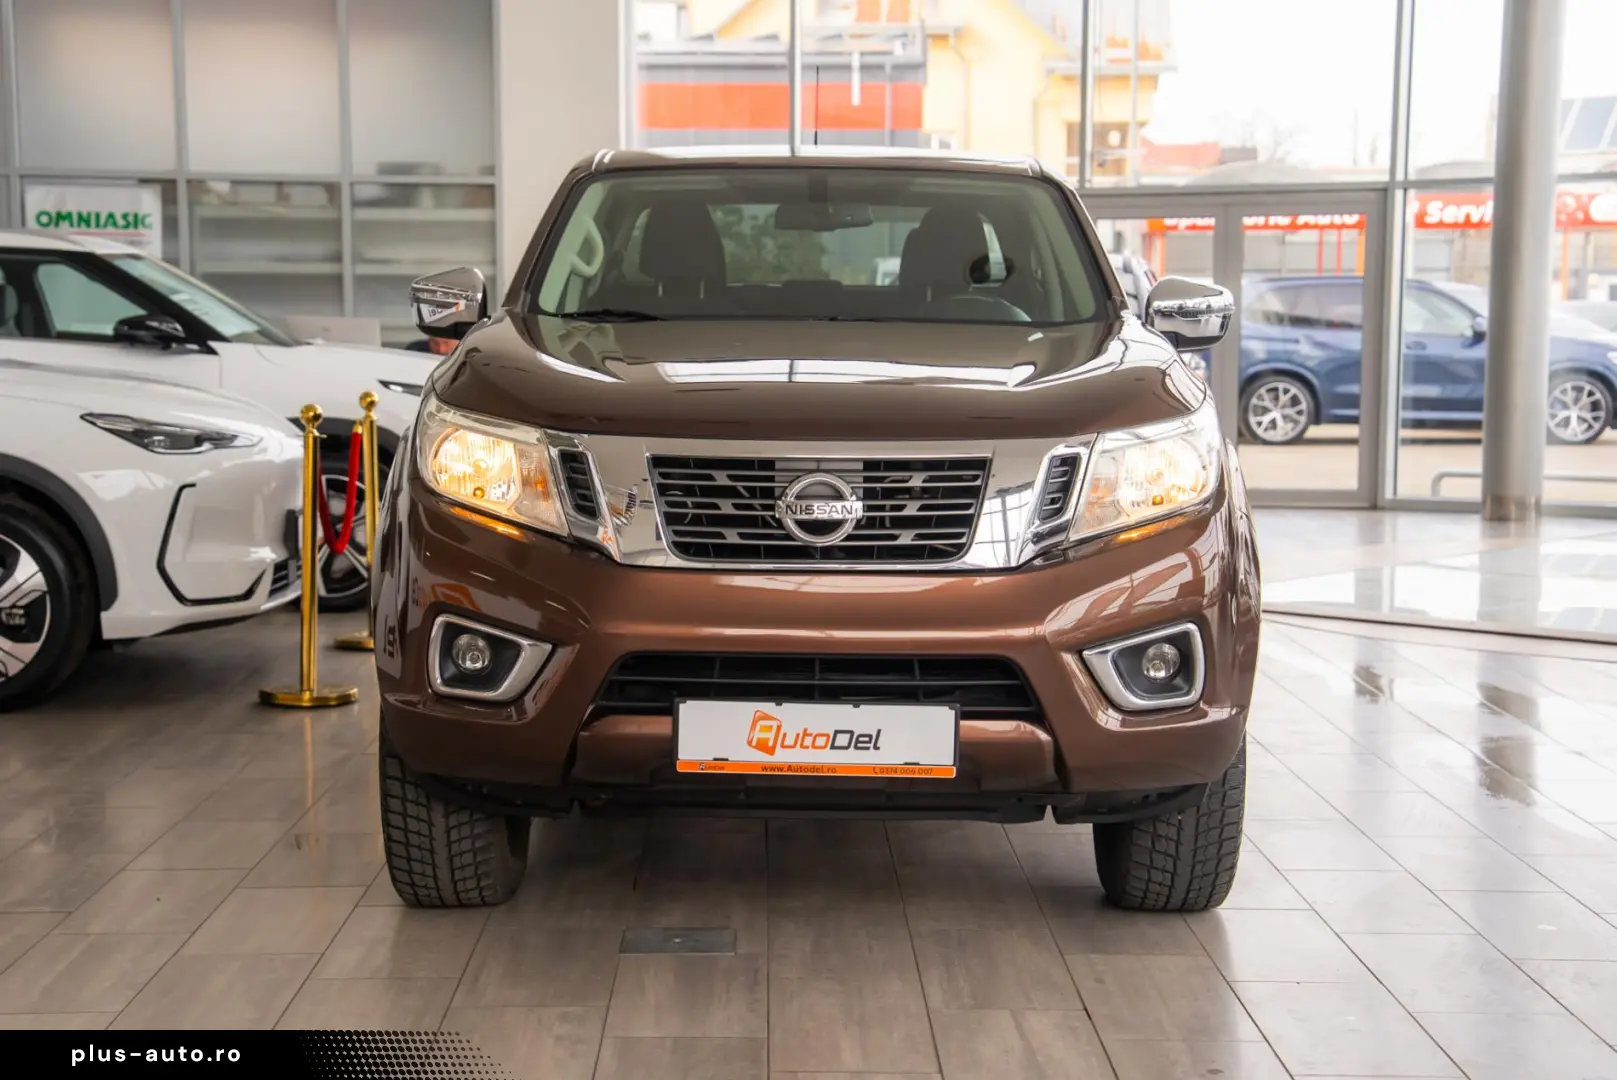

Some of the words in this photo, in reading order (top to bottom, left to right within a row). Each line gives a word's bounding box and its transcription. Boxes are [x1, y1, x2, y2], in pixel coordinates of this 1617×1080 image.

[35, 210, 152, 230] OMNIASIG
[785, 504, 853, 515] NISSAN
[746, 709, 882, 756] AutoDel
[760, 764, 837, 774] www.Autodel.ro
